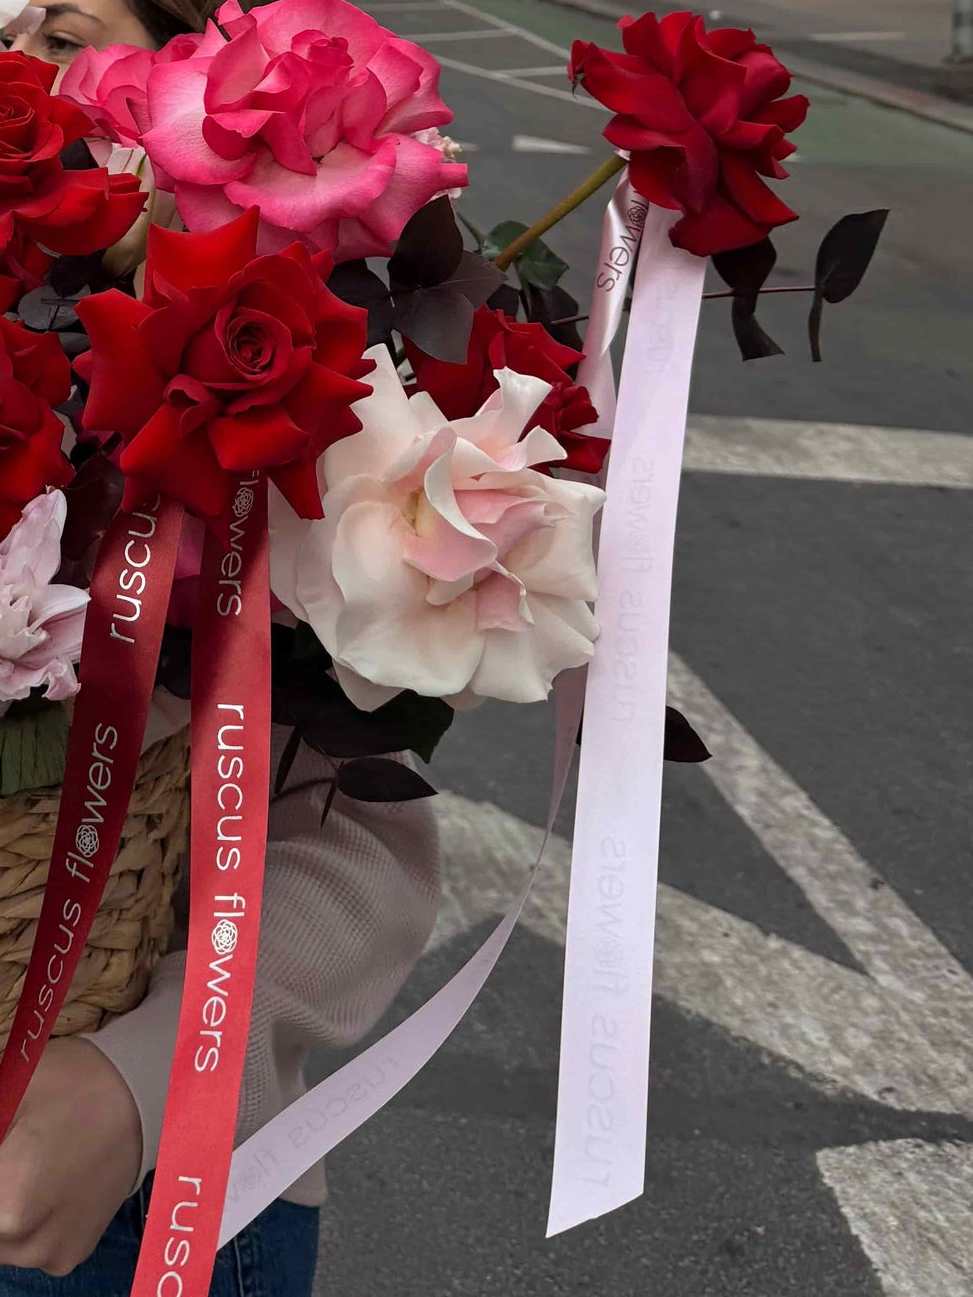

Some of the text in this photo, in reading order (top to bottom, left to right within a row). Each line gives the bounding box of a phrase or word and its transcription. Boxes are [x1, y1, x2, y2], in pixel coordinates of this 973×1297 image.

[596, 190, 648, 292] lowers
[217, 470, 260, 616] lowers
[20, 722, 118, 1062] ruscus flowers
[194, 703, 246, 1073] ruscus flowers
